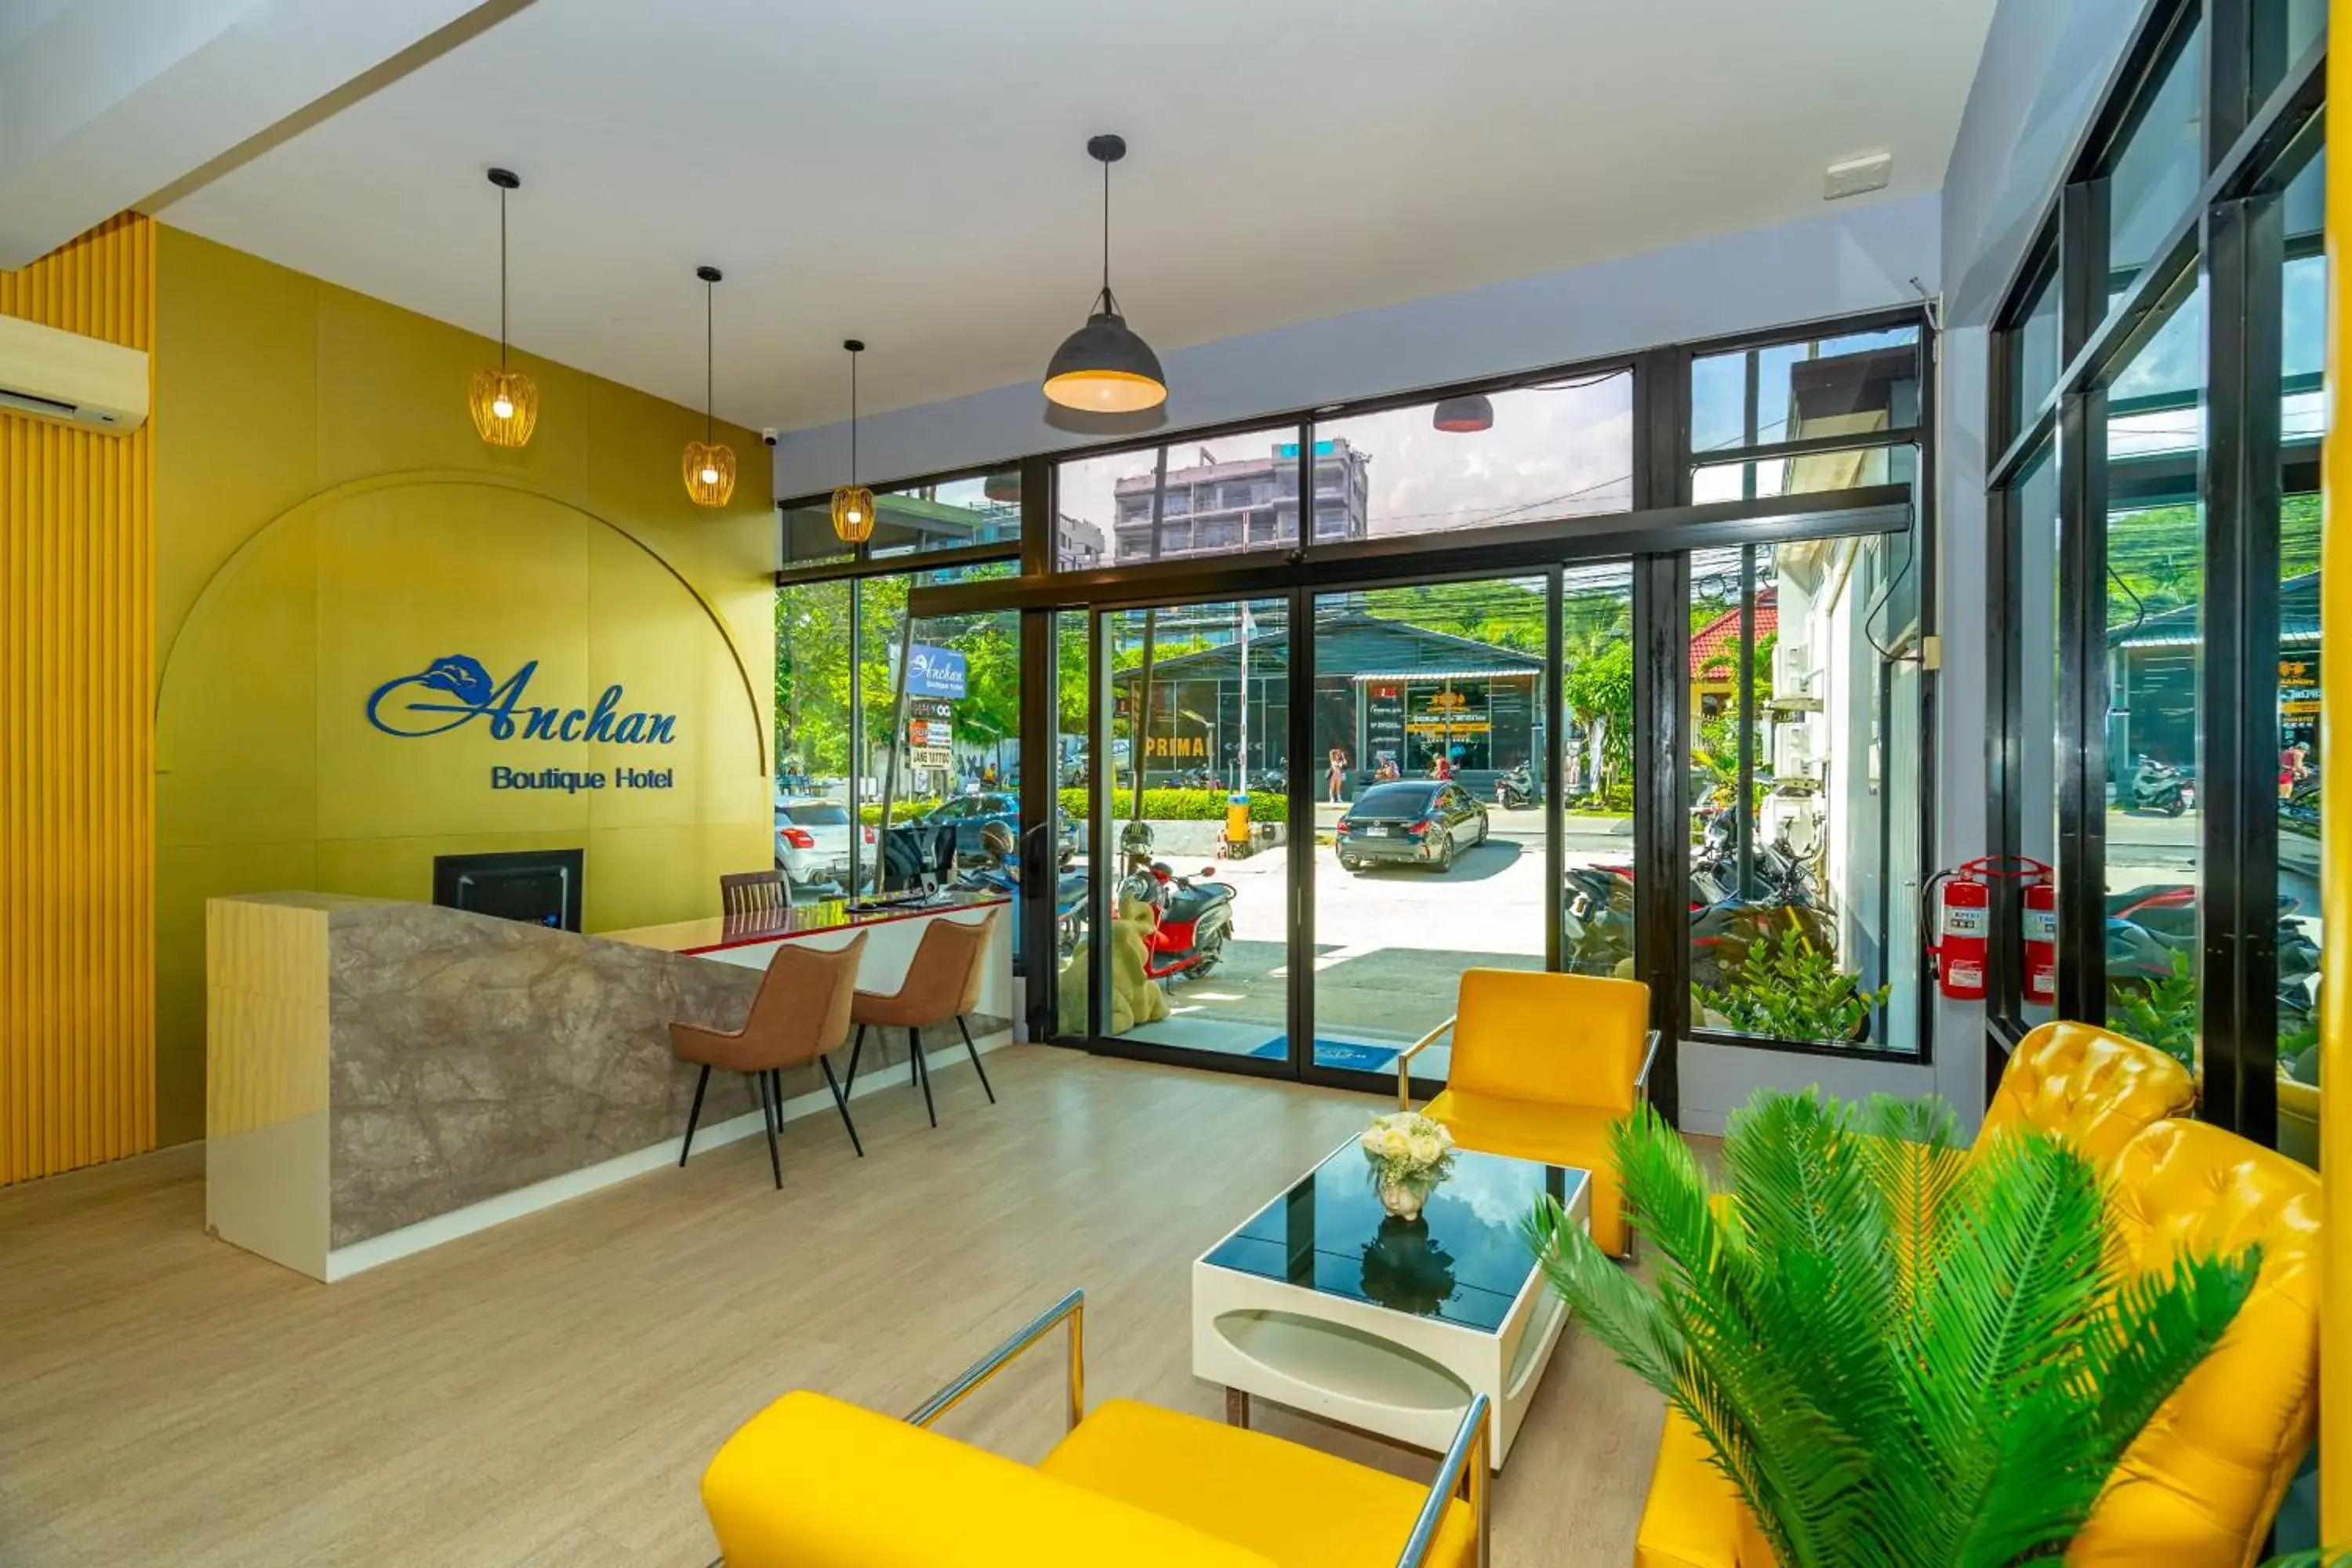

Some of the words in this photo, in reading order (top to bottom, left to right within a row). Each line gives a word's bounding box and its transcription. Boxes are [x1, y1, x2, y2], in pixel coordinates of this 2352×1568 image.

[366, 654, 676, 744] Anchan
[491, 766, 605, 793] Boutique
[615, 768, 673, 789] Hotel
